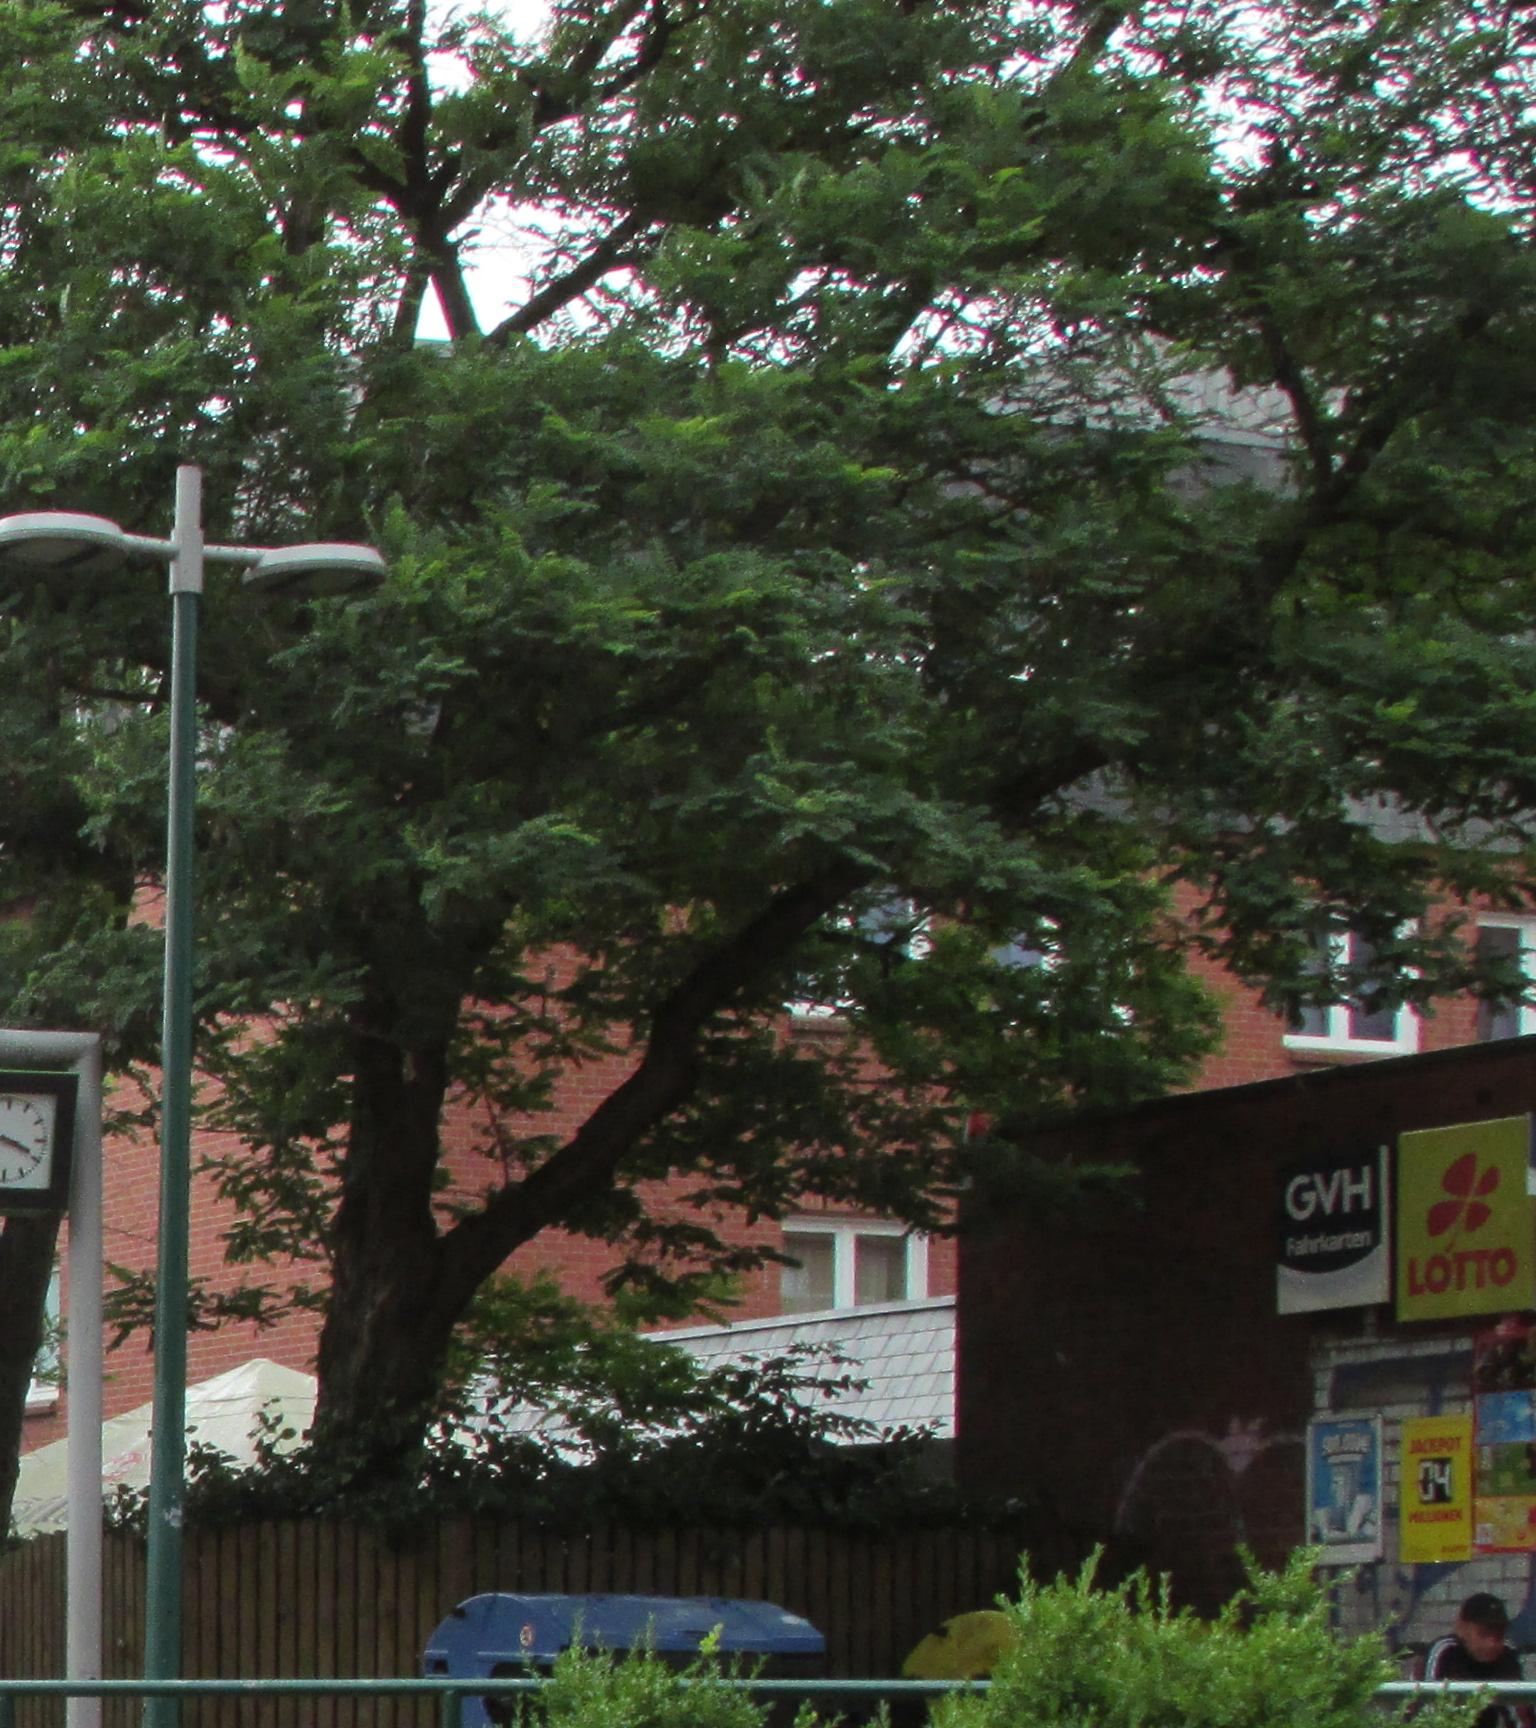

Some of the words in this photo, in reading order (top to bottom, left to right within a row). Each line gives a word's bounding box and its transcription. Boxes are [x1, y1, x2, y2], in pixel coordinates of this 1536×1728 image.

[1285, 1165, 1373, 1221] GVH
[1285, 1230, 1372, 1257] Fahrkarten
[1407, 1247, 1518, 1297] LOTTO
